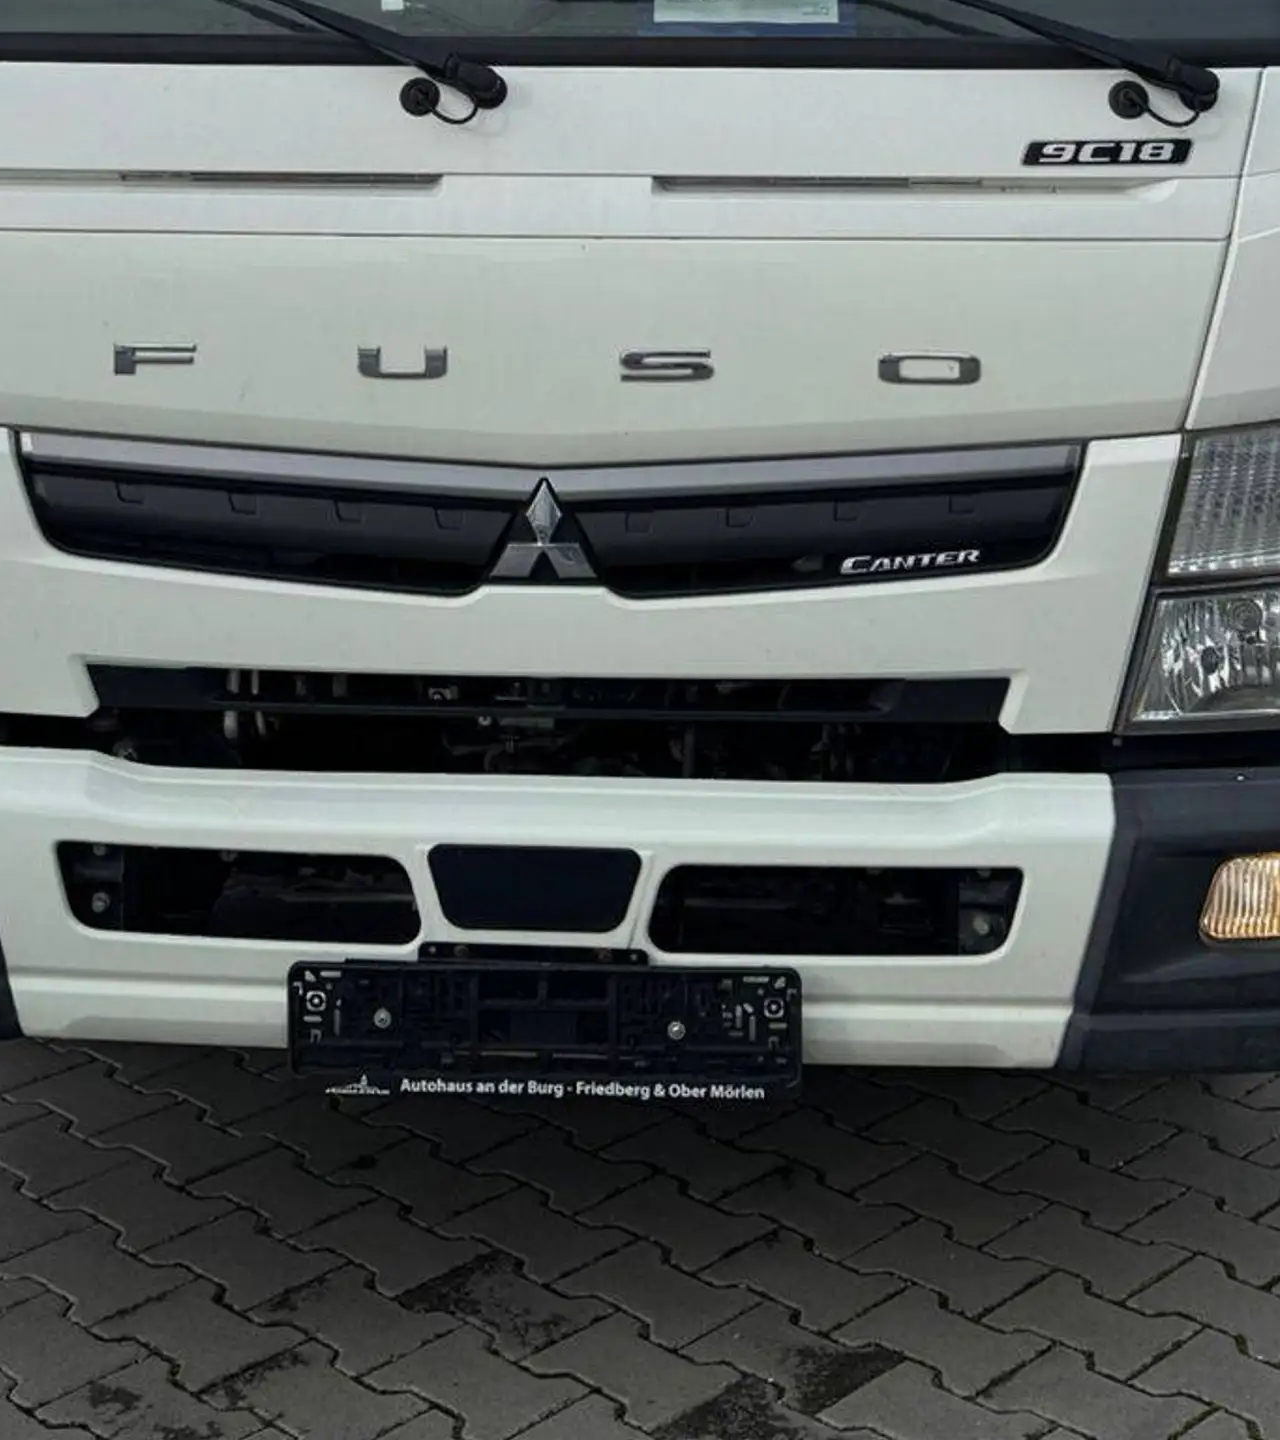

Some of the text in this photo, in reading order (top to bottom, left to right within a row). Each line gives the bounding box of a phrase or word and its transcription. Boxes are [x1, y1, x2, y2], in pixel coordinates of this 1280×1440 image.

[1039, 142, 1175, 163] 9C18
[113, 343, 981, 385] FUSO
[400, 1078, 472, 1093] Autohaus
[476, 1082, 495, 1093] an
[499, 1079, 524, 1094] der
[527, 1080, 564, 1098] Burg
[576, 1081, 650, 1100] Friedberg
[653, 1083, 665, 1097] &
[669, 1083, 708, 1098] Ober
